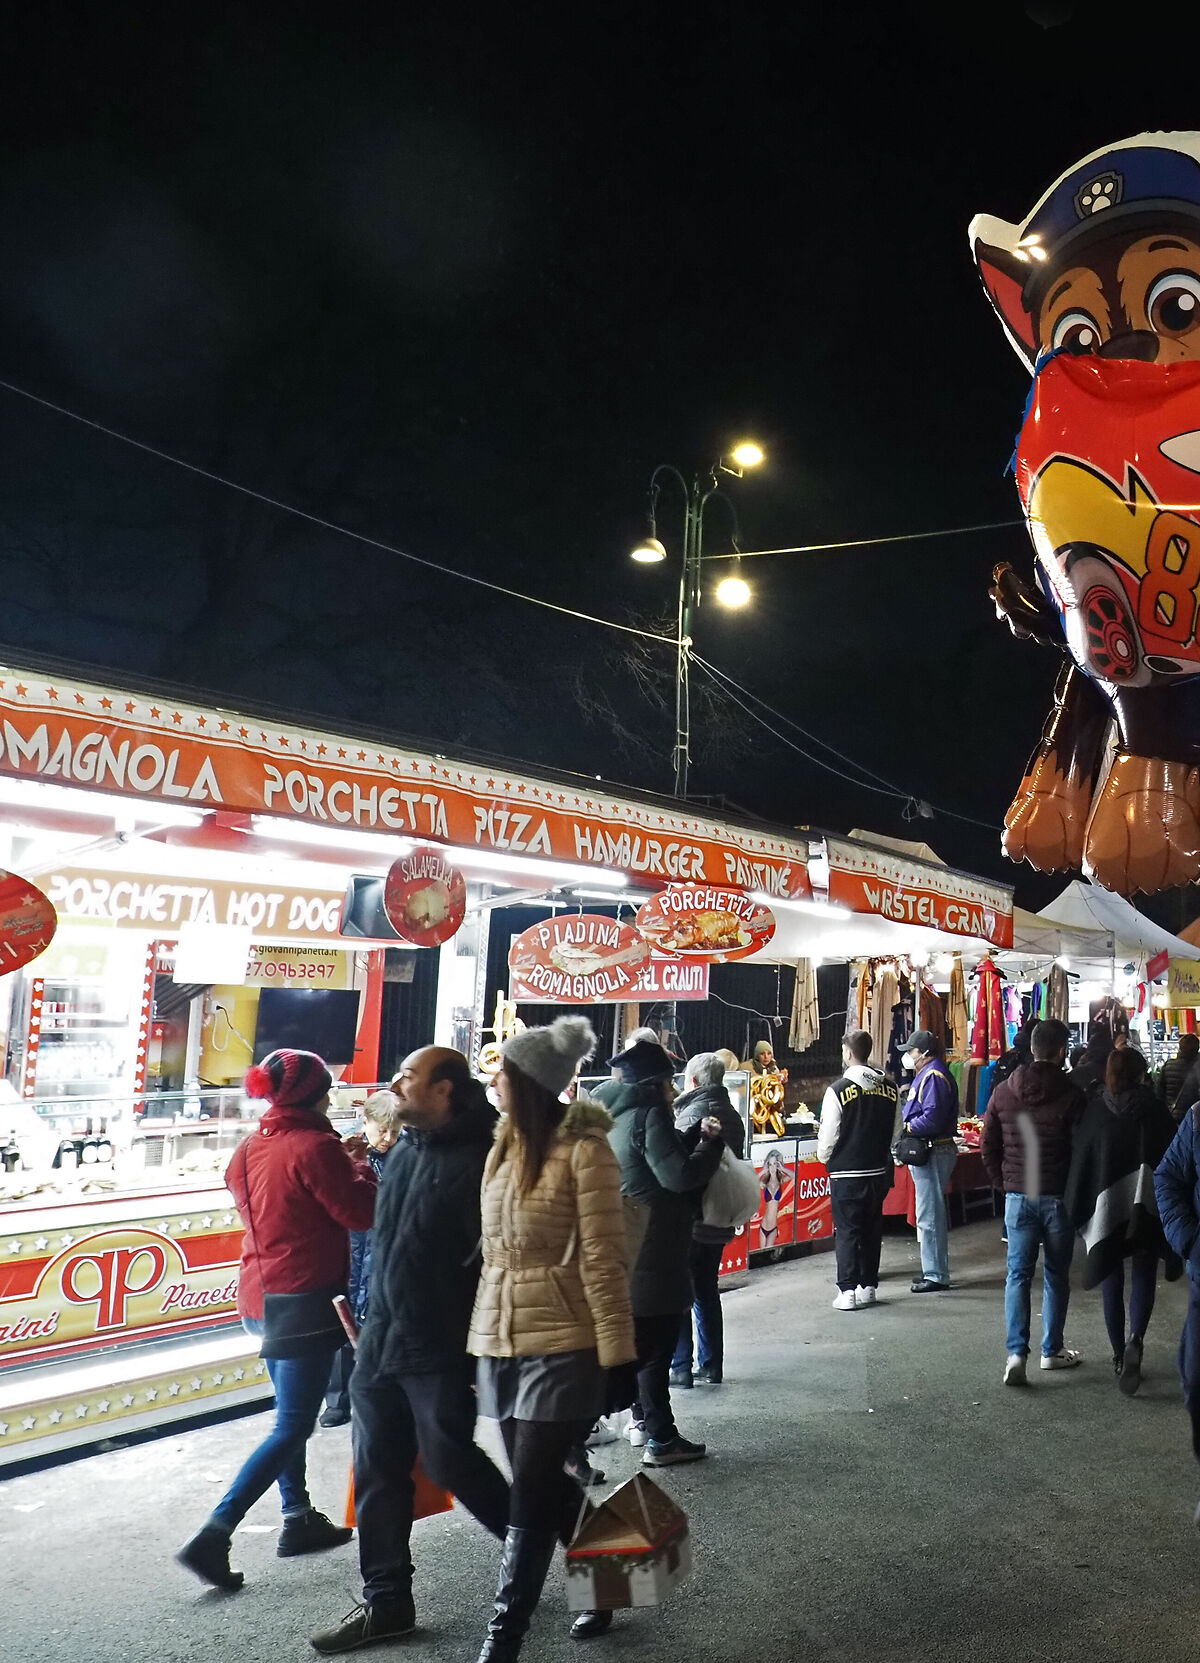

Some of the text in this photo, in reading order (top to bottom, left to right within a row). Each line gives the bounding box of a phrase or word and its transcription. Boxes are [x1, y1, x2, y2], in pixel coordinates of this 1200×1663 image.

[0, 721, 223, 803] MAGNOLA
[264, 764, 449, 838] PORCHETTA
[475, 806, 552, 855] PIZZA
[575, 824, 707, 881] HAMBURGER
[724, 853, 792, 898] PATATINE
[401, 855, 453, 889] SALAMELLA
[48, 875, 341, 933] PORCHETTA HOT DOG
[659, 889, 757, 921] PORCHETTA
[538, 920, 621, 950] PIADINA
[527, 964, 630, 999] ROMAGNOLA
[840, 1084, 859, 1106] LOS
